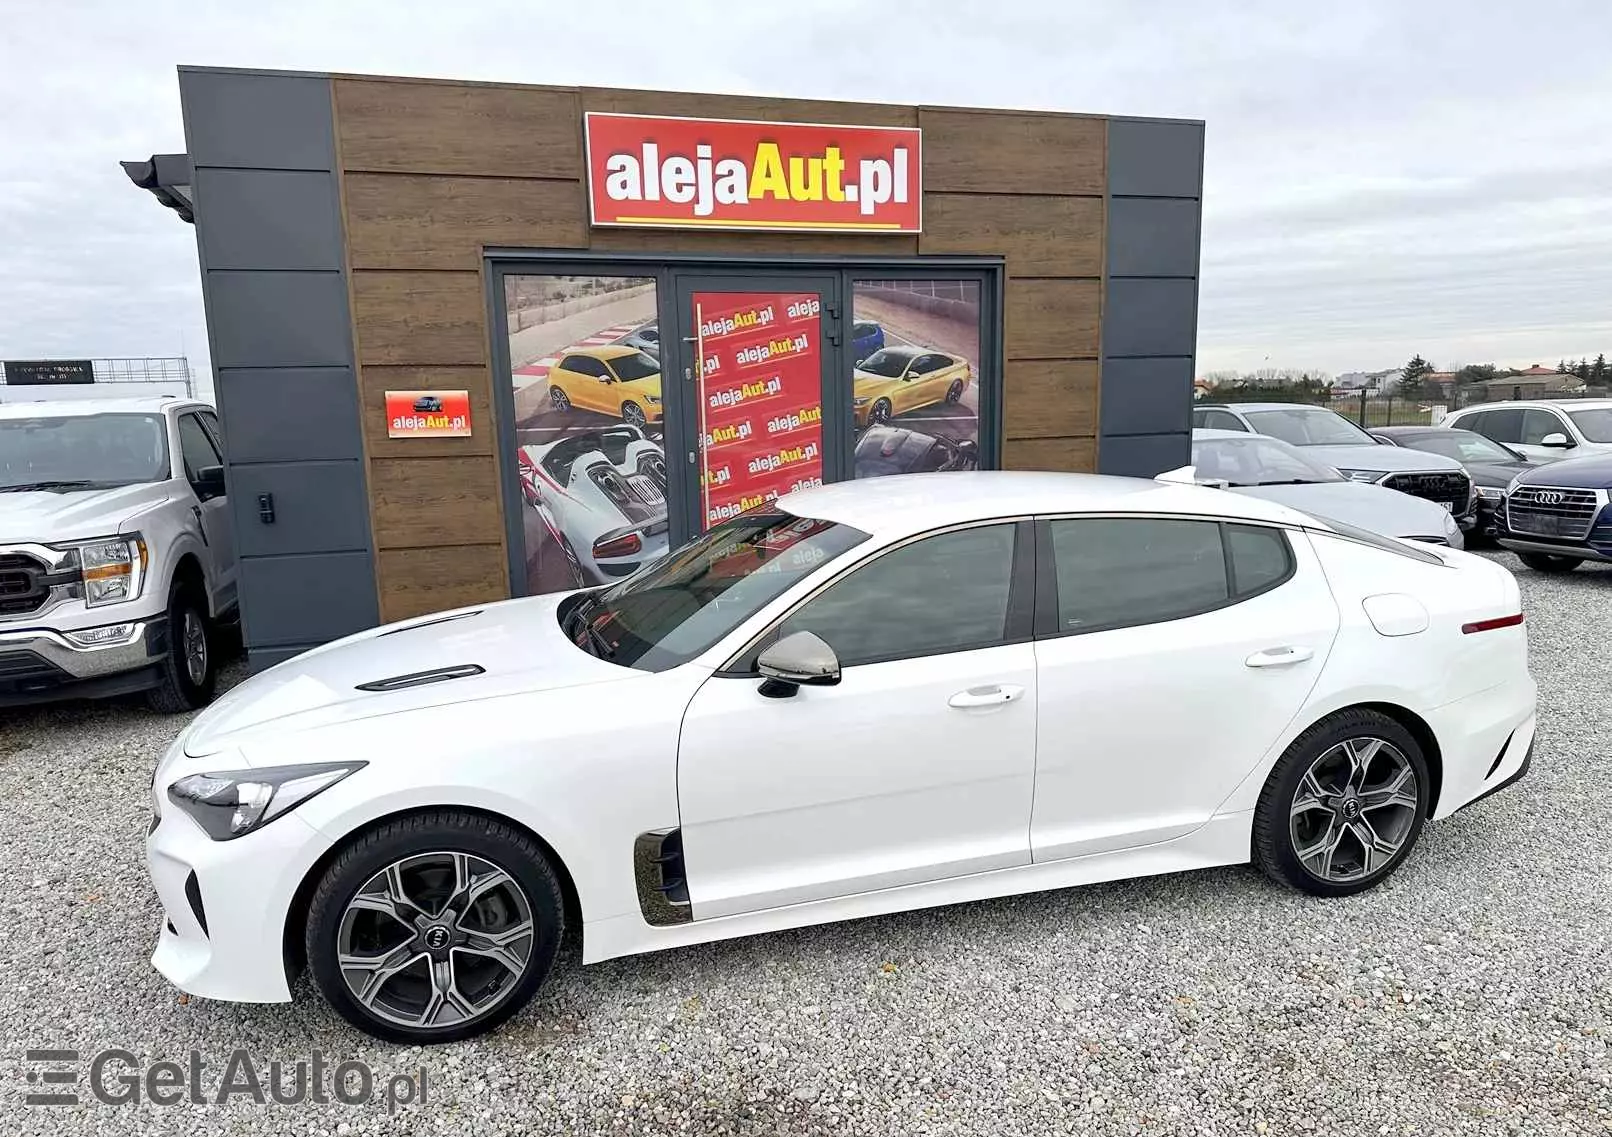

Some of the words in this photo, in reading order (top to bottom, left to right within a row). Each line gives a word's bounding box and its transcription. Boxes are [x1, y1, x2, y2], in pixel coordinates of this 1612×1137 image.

[605, 142, 908, 216] alejaAut.pl
[701, 306, 774, 336] alejaAut.pl
[787, 299, 820, 318] aleja
[735, 333, 809, 364] alejaAut.pl
[709, 376, 782, 407] alejaAut.pl
[393, 415, 466, 431] alejaAut.pl
[767, 406, 822, 433] alejaAut
[748, 443, 818, 473] alejaAut.pl
